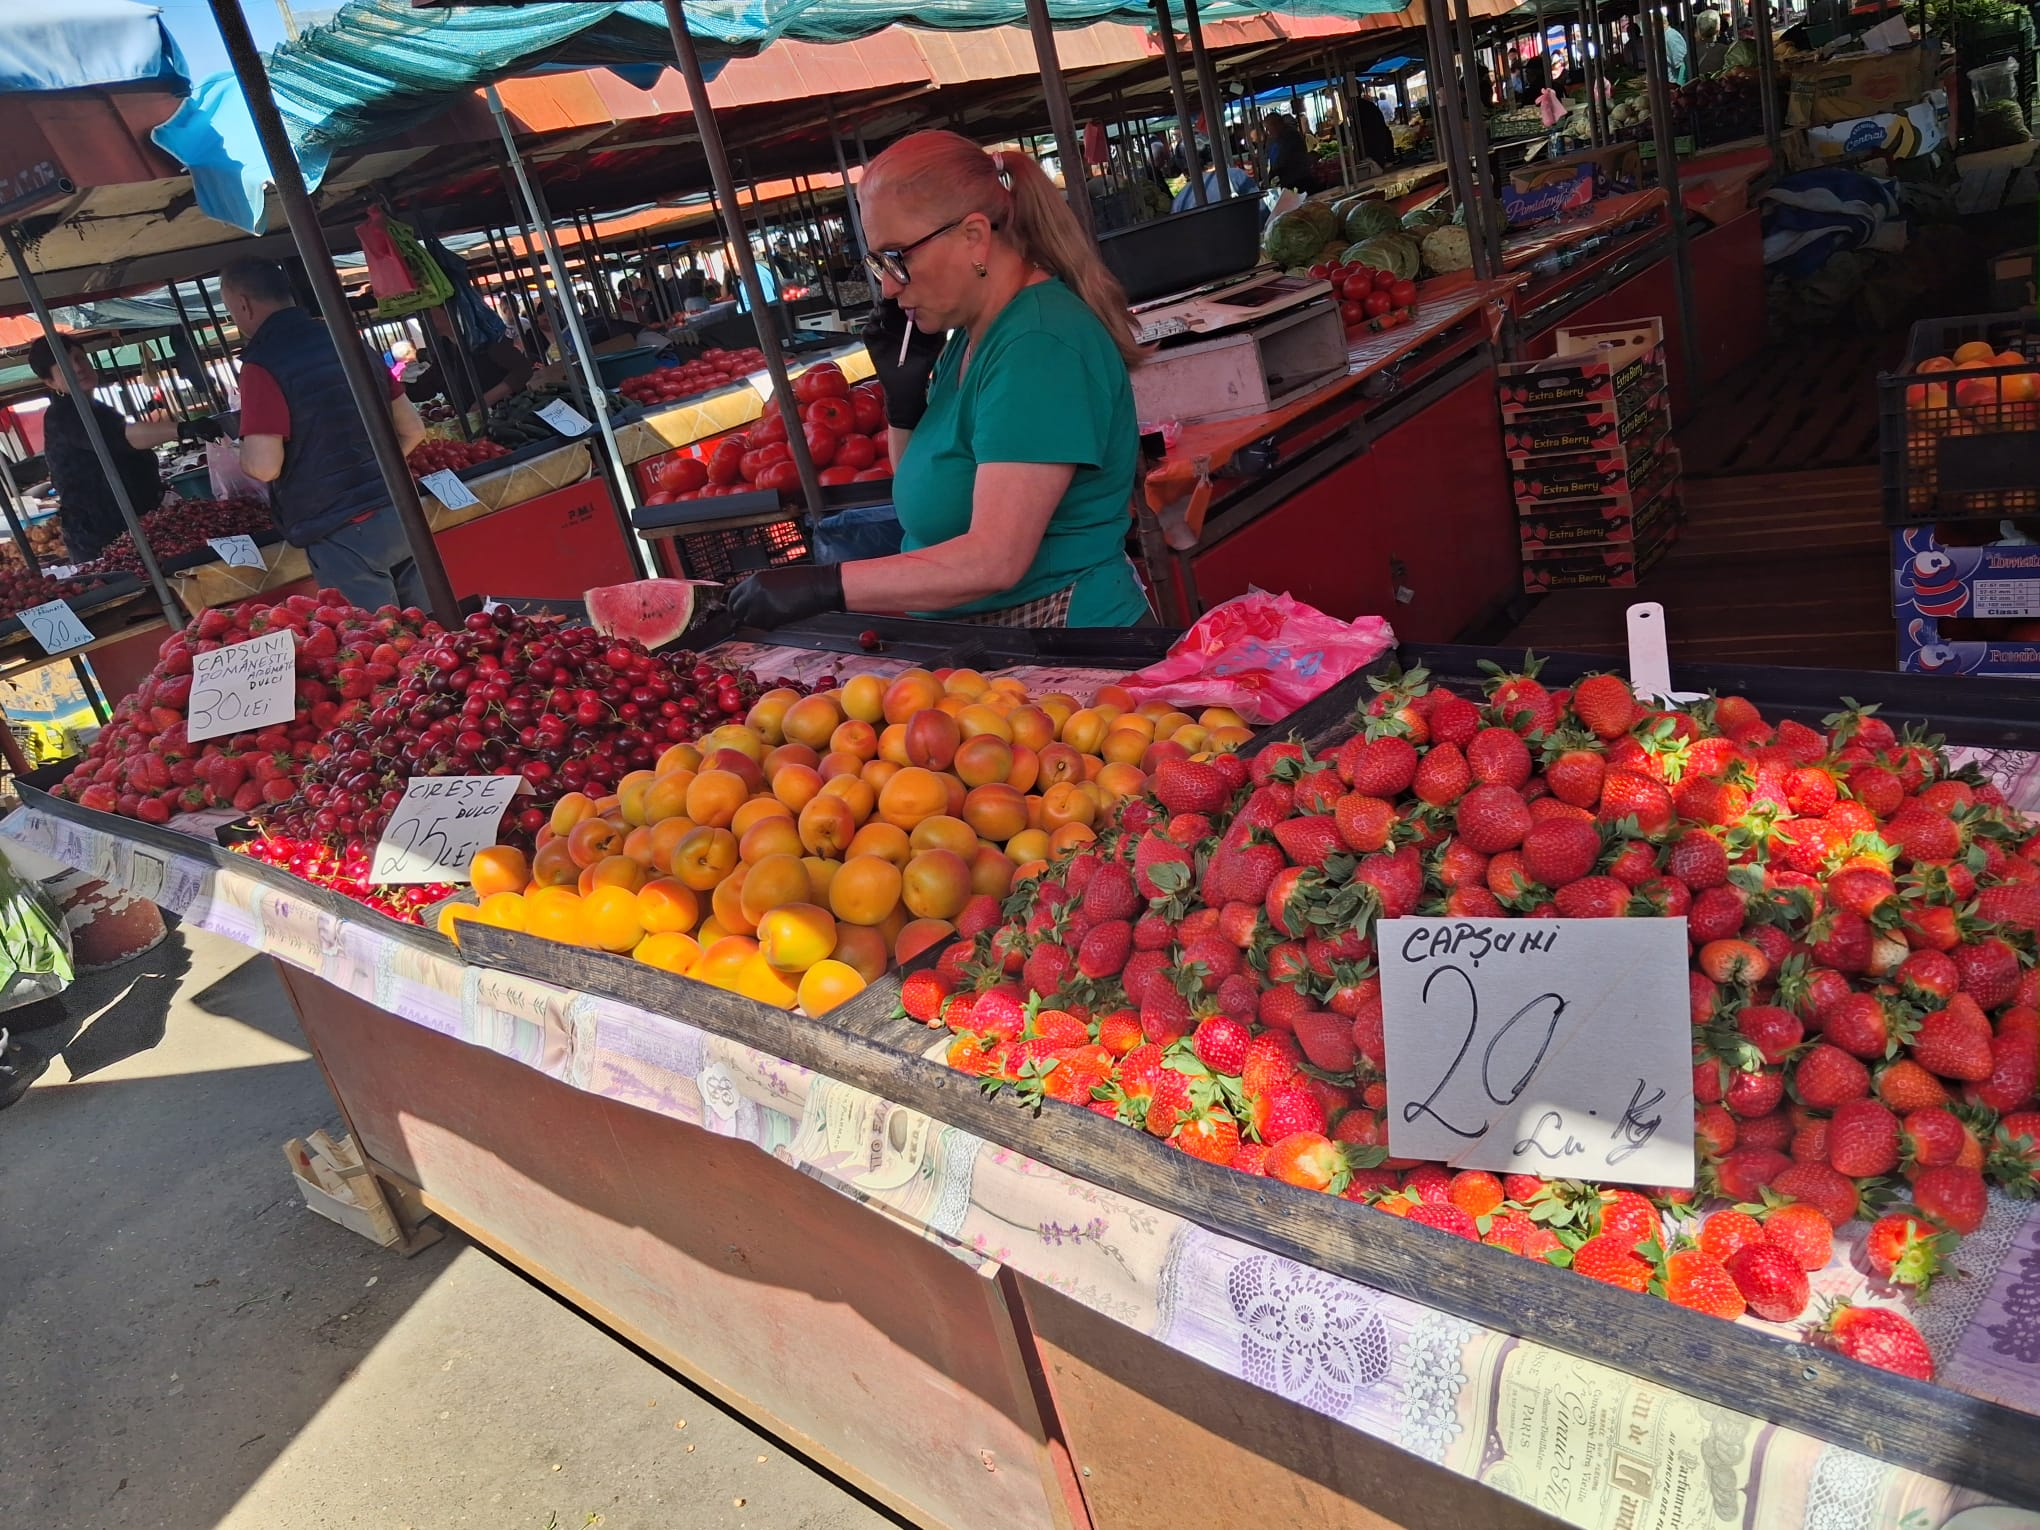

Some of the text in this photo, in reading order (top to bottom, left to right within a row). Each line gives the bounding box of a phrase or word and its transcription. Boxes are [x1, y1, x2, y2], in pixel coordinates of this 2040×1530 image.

[1846, 130, 1885, 152] Central
[1616, 371, 1629, 389] Extra
[1528, 387, 1584, 401] Extra Berry
[1534, 436, 1590, 448] Extra Berry
[432, 479, 468, 507] 20
[1543, 482, 1599, 494] Extra Berry
[1549, 528, 1604, 540] Extra Berry
[220, 543, 259, 565] 25
[32, 617, 70, 649] 20
[249, 675, 283, 691] DULCI
[193, 688, 242, 730] 30
[381, 817, 448, 877] 25
[1403, 964, 1571, 1139] 20
[1520, 1403, 1536, 1448] PARIS
[1628, 1424, 1649, 1446] de
[1663, 1448, 1675, 1495] PRINCIPE
[1659, 1496, 1669, 1517] DES
